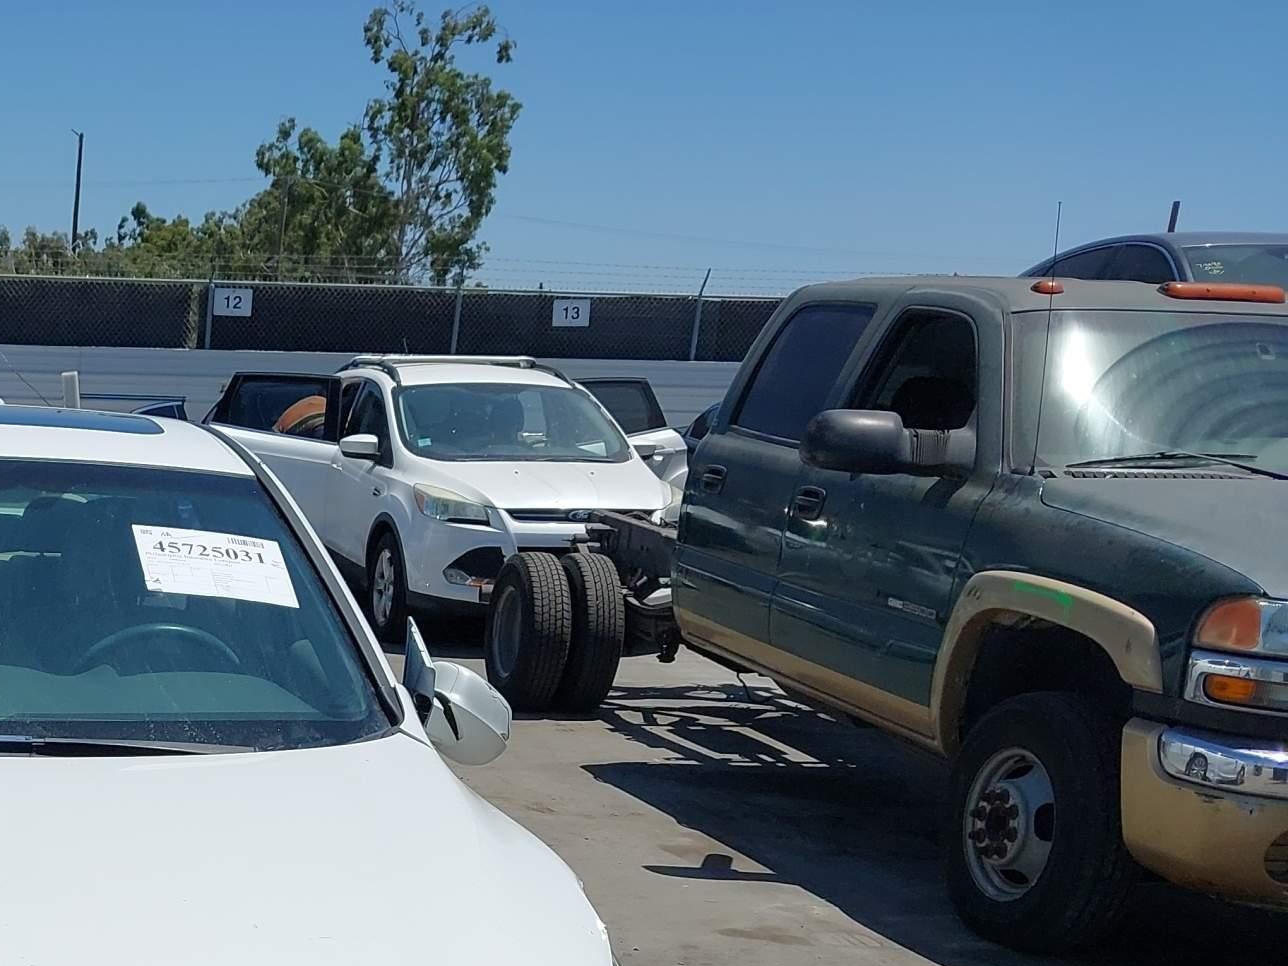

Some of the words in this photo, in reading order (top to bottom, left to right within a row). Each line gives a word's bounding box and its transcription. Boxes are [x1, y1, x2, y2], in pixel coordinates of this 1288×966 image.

[224, 295, 242, 309] 12
[562, 306, 580, 320] 13
[152, 539, 265, 565] 45725031
